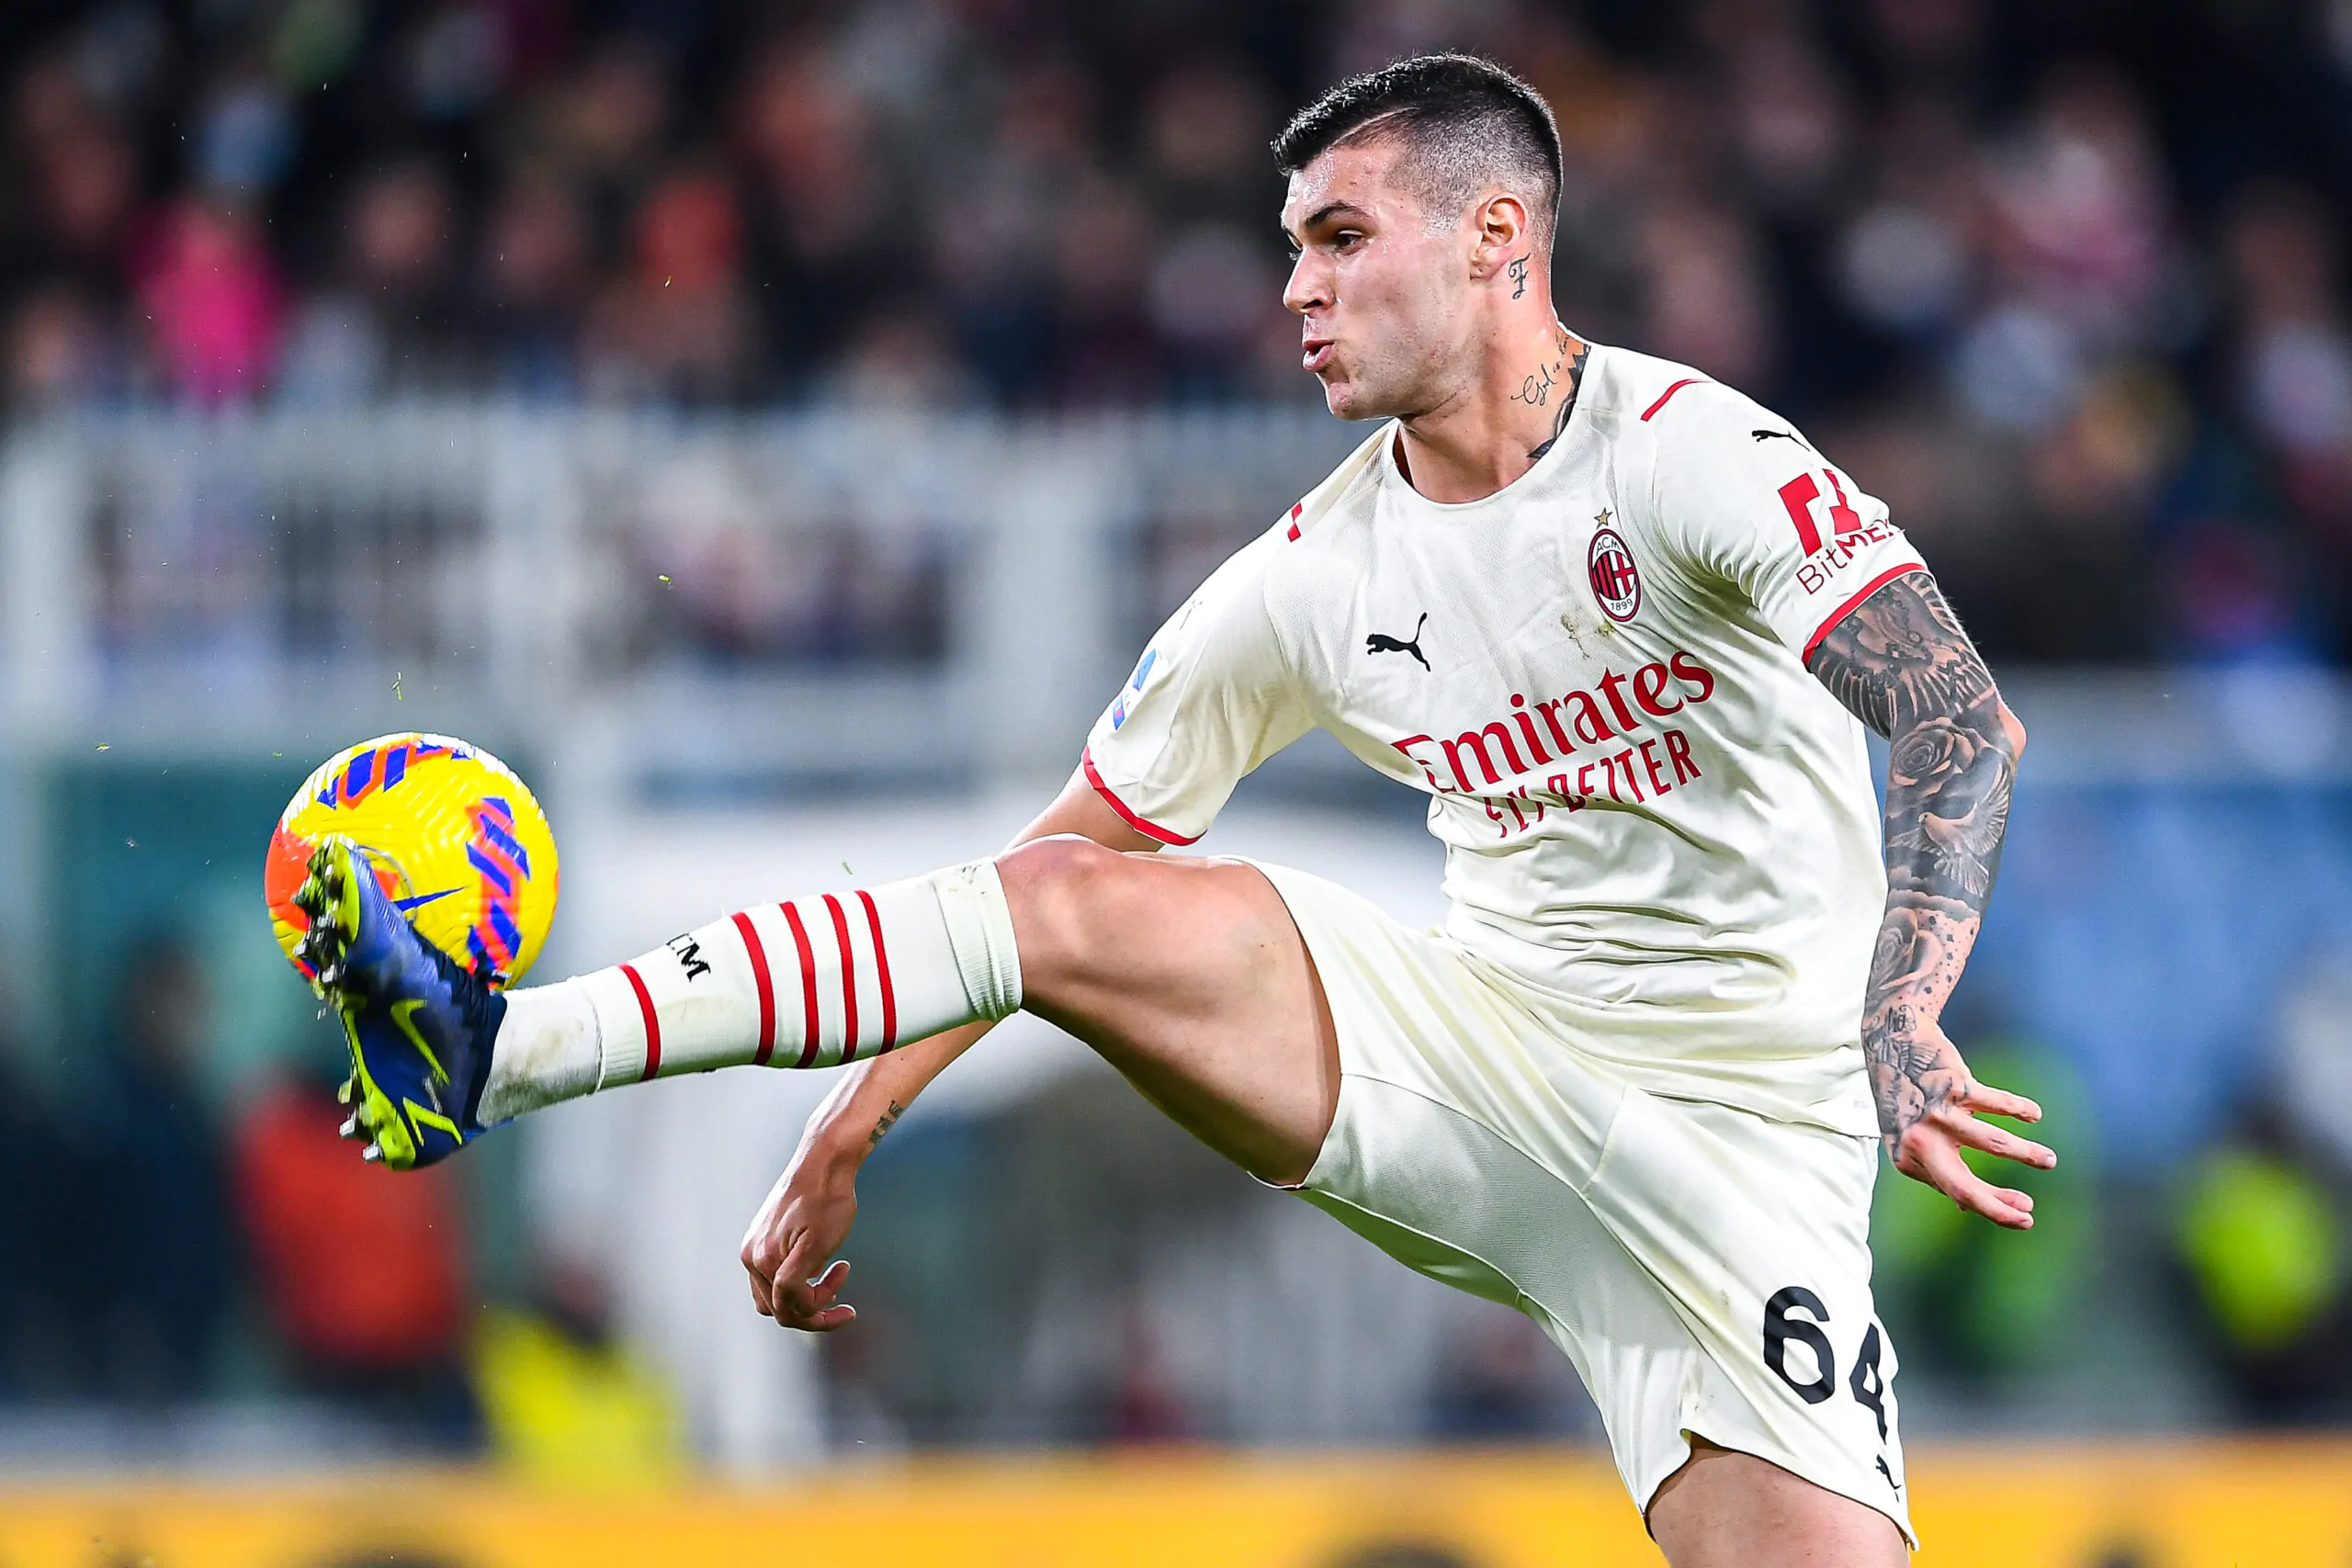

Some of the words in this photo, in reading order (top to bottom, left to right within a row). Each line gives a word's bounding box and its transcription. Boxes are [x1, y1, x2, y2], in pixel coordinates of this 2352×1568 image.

[1595, 536, 1621, 557] ACM
[1610, 598, 1634, 611] 1899
[1390, 650, 1715, 794] Emirates
[1763, 1286, 1888, 1445] 64
